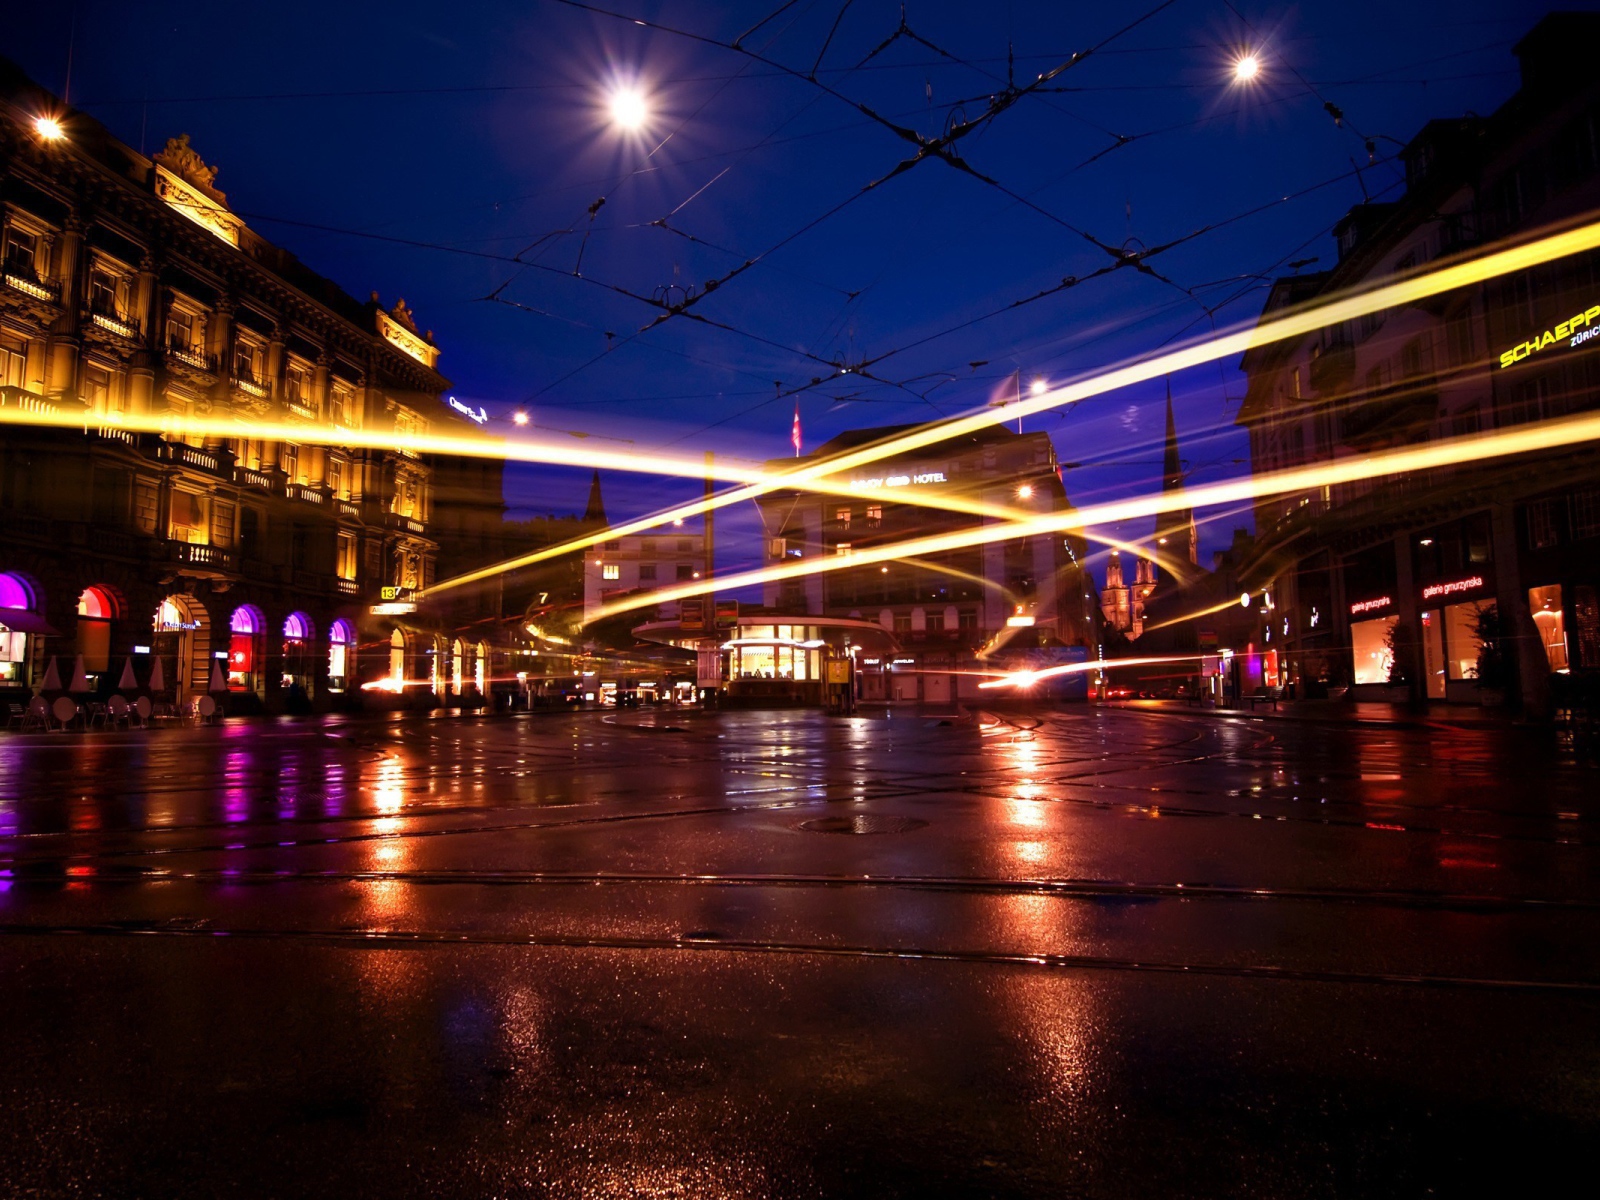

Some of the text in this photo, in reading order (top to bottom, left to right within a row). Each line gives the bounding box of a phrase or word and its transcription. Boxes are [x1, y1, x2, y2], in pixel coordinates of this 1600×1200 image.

[1570, 324, 1600, 347] ZÜRIC
[913, 473, 947, 484] HOTEL
[382, 588, 395, 598] 13
[395, 586, 402, 596] 7
[539, 592, 548, 604] 7
[1016, 605, 1023, 614] 2
